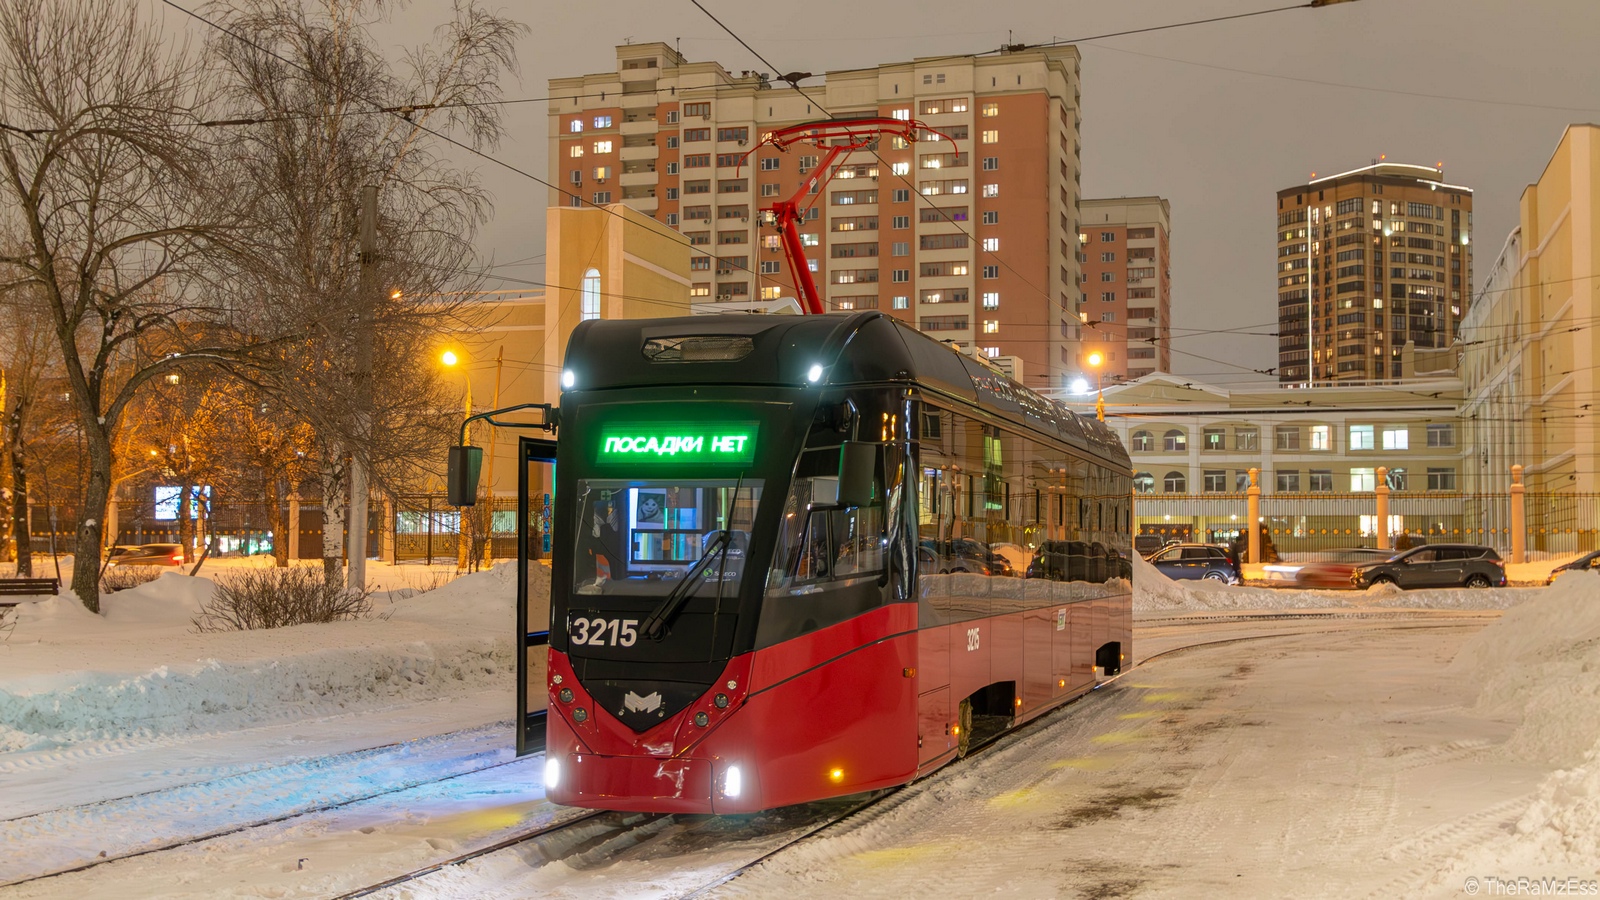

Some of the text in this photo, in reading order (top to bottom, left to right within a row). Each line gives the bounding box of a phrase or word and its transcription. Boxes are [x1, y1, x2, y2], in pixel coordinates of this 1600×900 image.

[604, 435, 748, 456] ПОСАДКИ НЕТ
[571, 617, 639, 647] 3215
[967, 627, 980, 651] 3215
